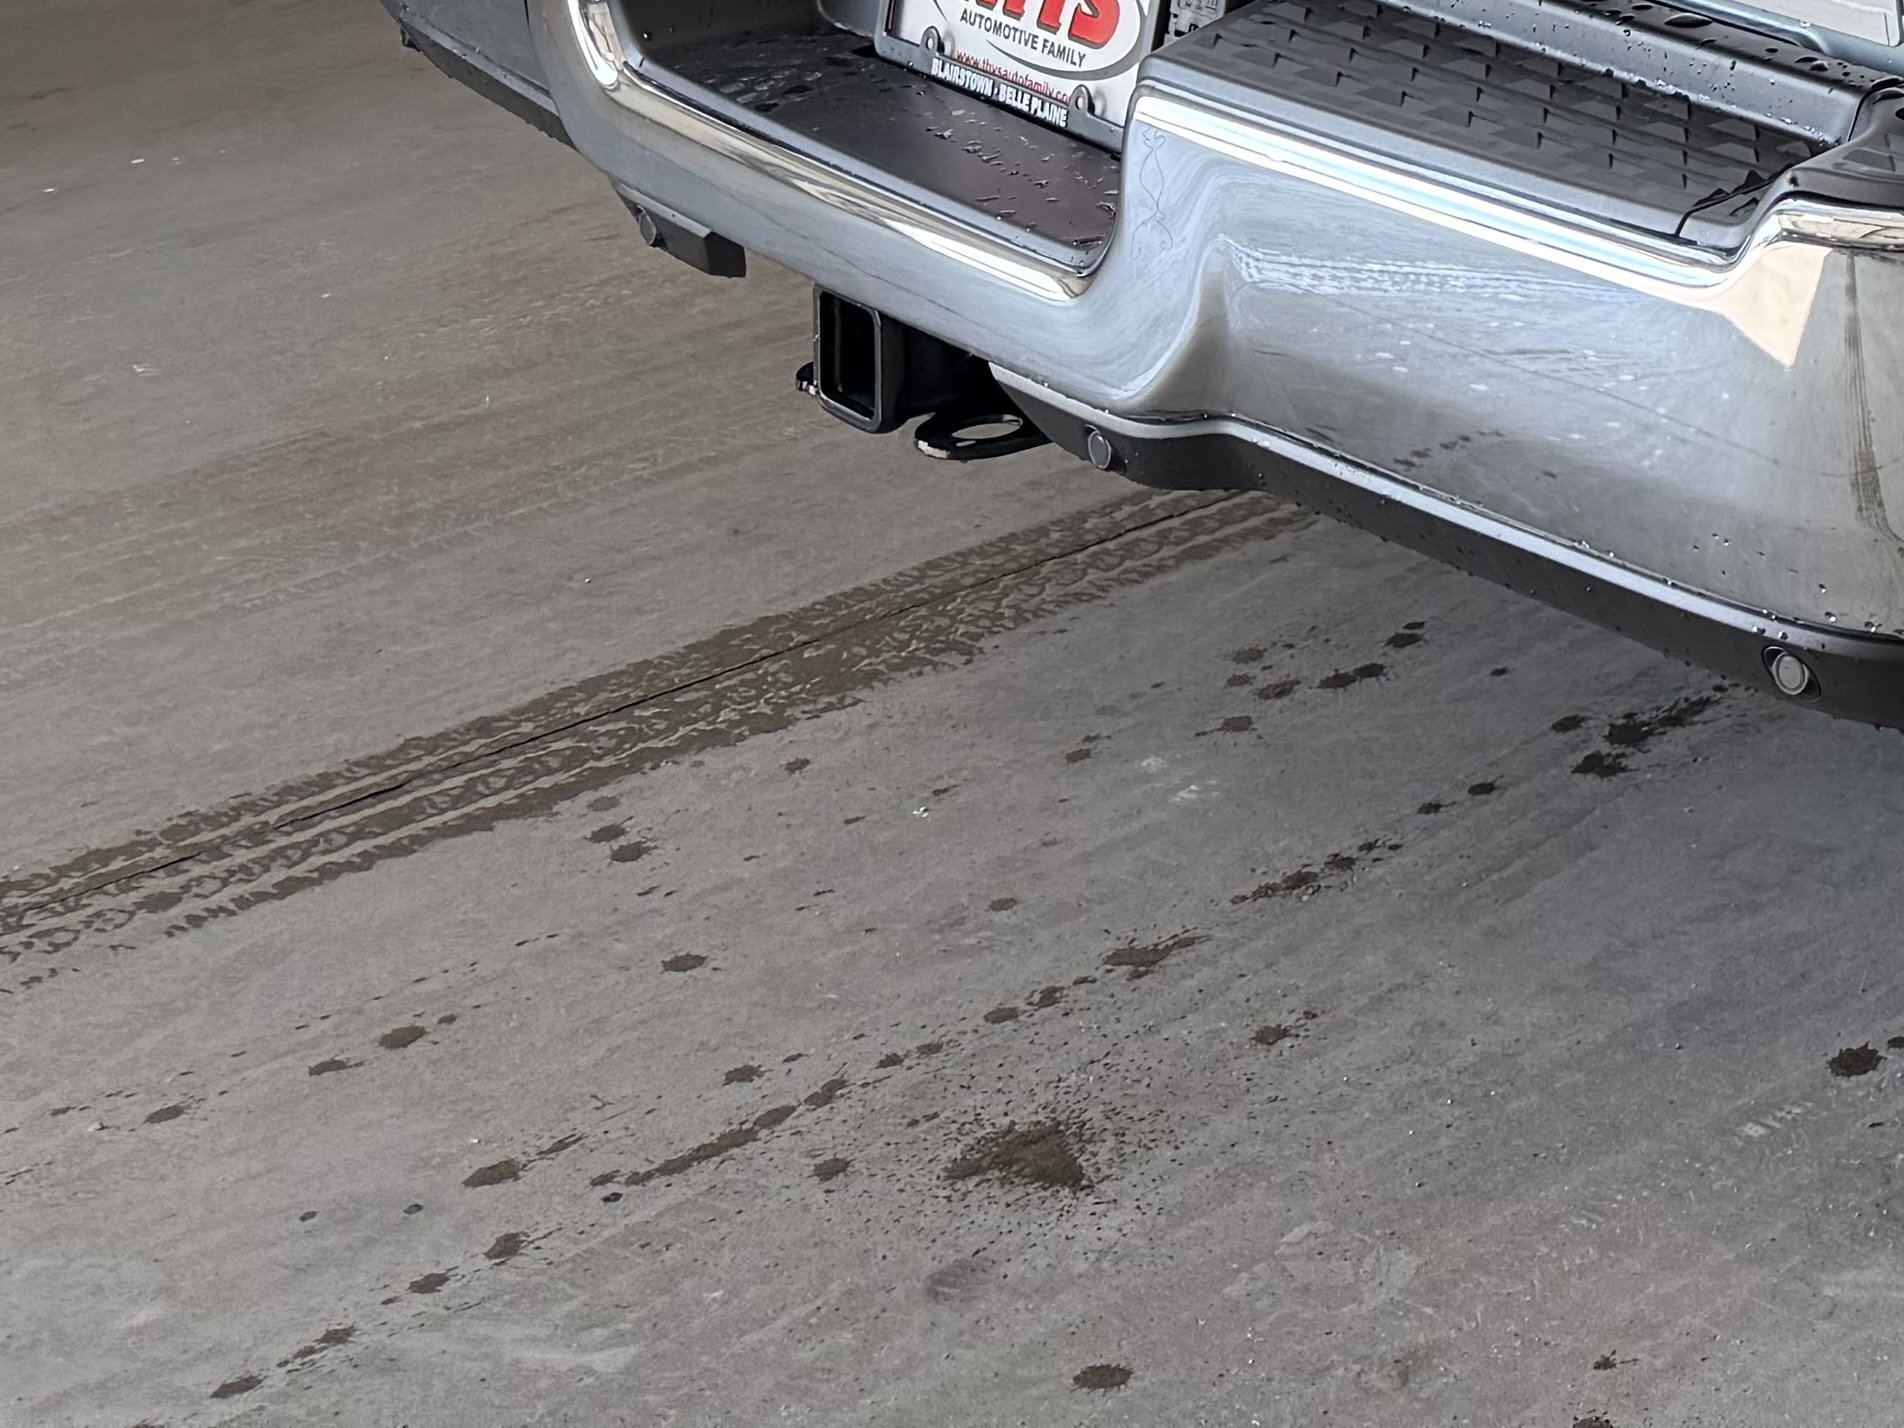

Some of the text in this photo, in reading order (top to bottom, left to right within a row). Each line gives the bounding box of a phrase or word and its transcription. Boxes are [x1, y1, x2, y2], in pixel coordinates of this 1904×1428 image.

[960, 8, 1087, 68] AUTOMOTIVE FAMILY
[931, 58, 1069, 128] BLAIRSTOWN BELLE PLAINE
